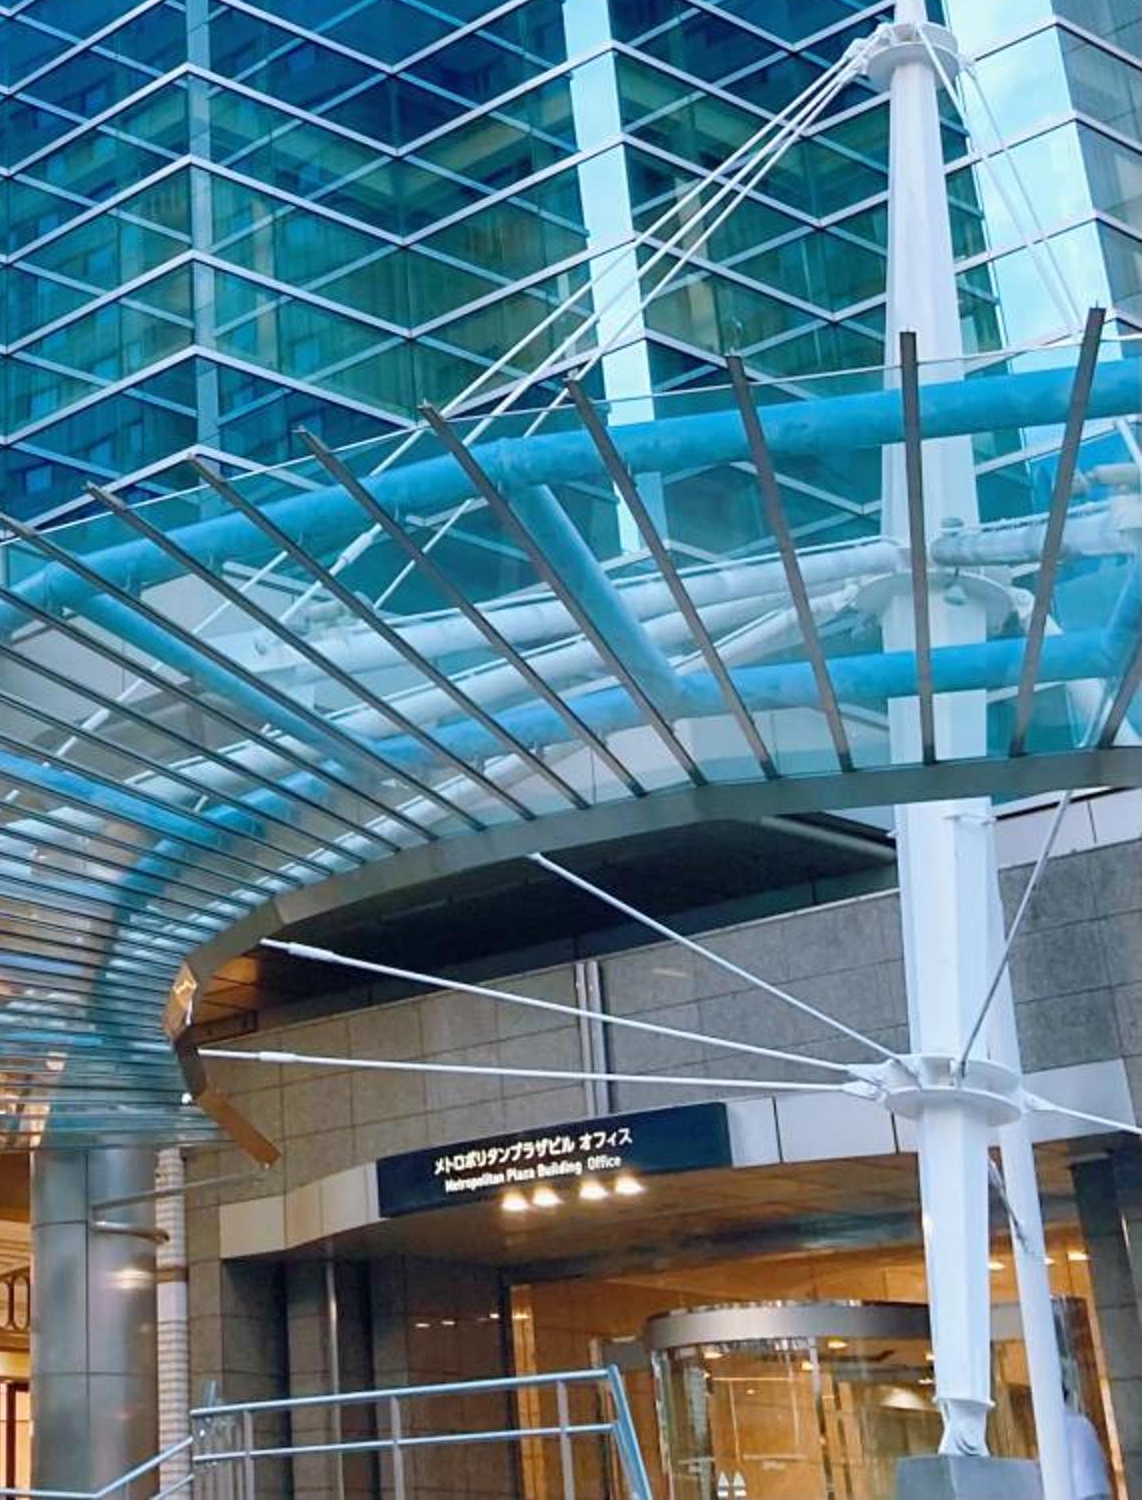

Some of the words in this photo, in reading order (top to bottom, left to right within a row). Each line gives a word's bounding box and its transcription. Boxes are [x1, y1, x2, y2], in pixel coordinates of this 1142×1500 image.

[579, 1128, 633, 1150] オフィス
[445, 1172, 505, 1192] Metropolitan
[507, 1166, 535, 1182] Plaza
[537, 1160, 583, 1177] Building
[587, 1154, 622, 1171] Office
